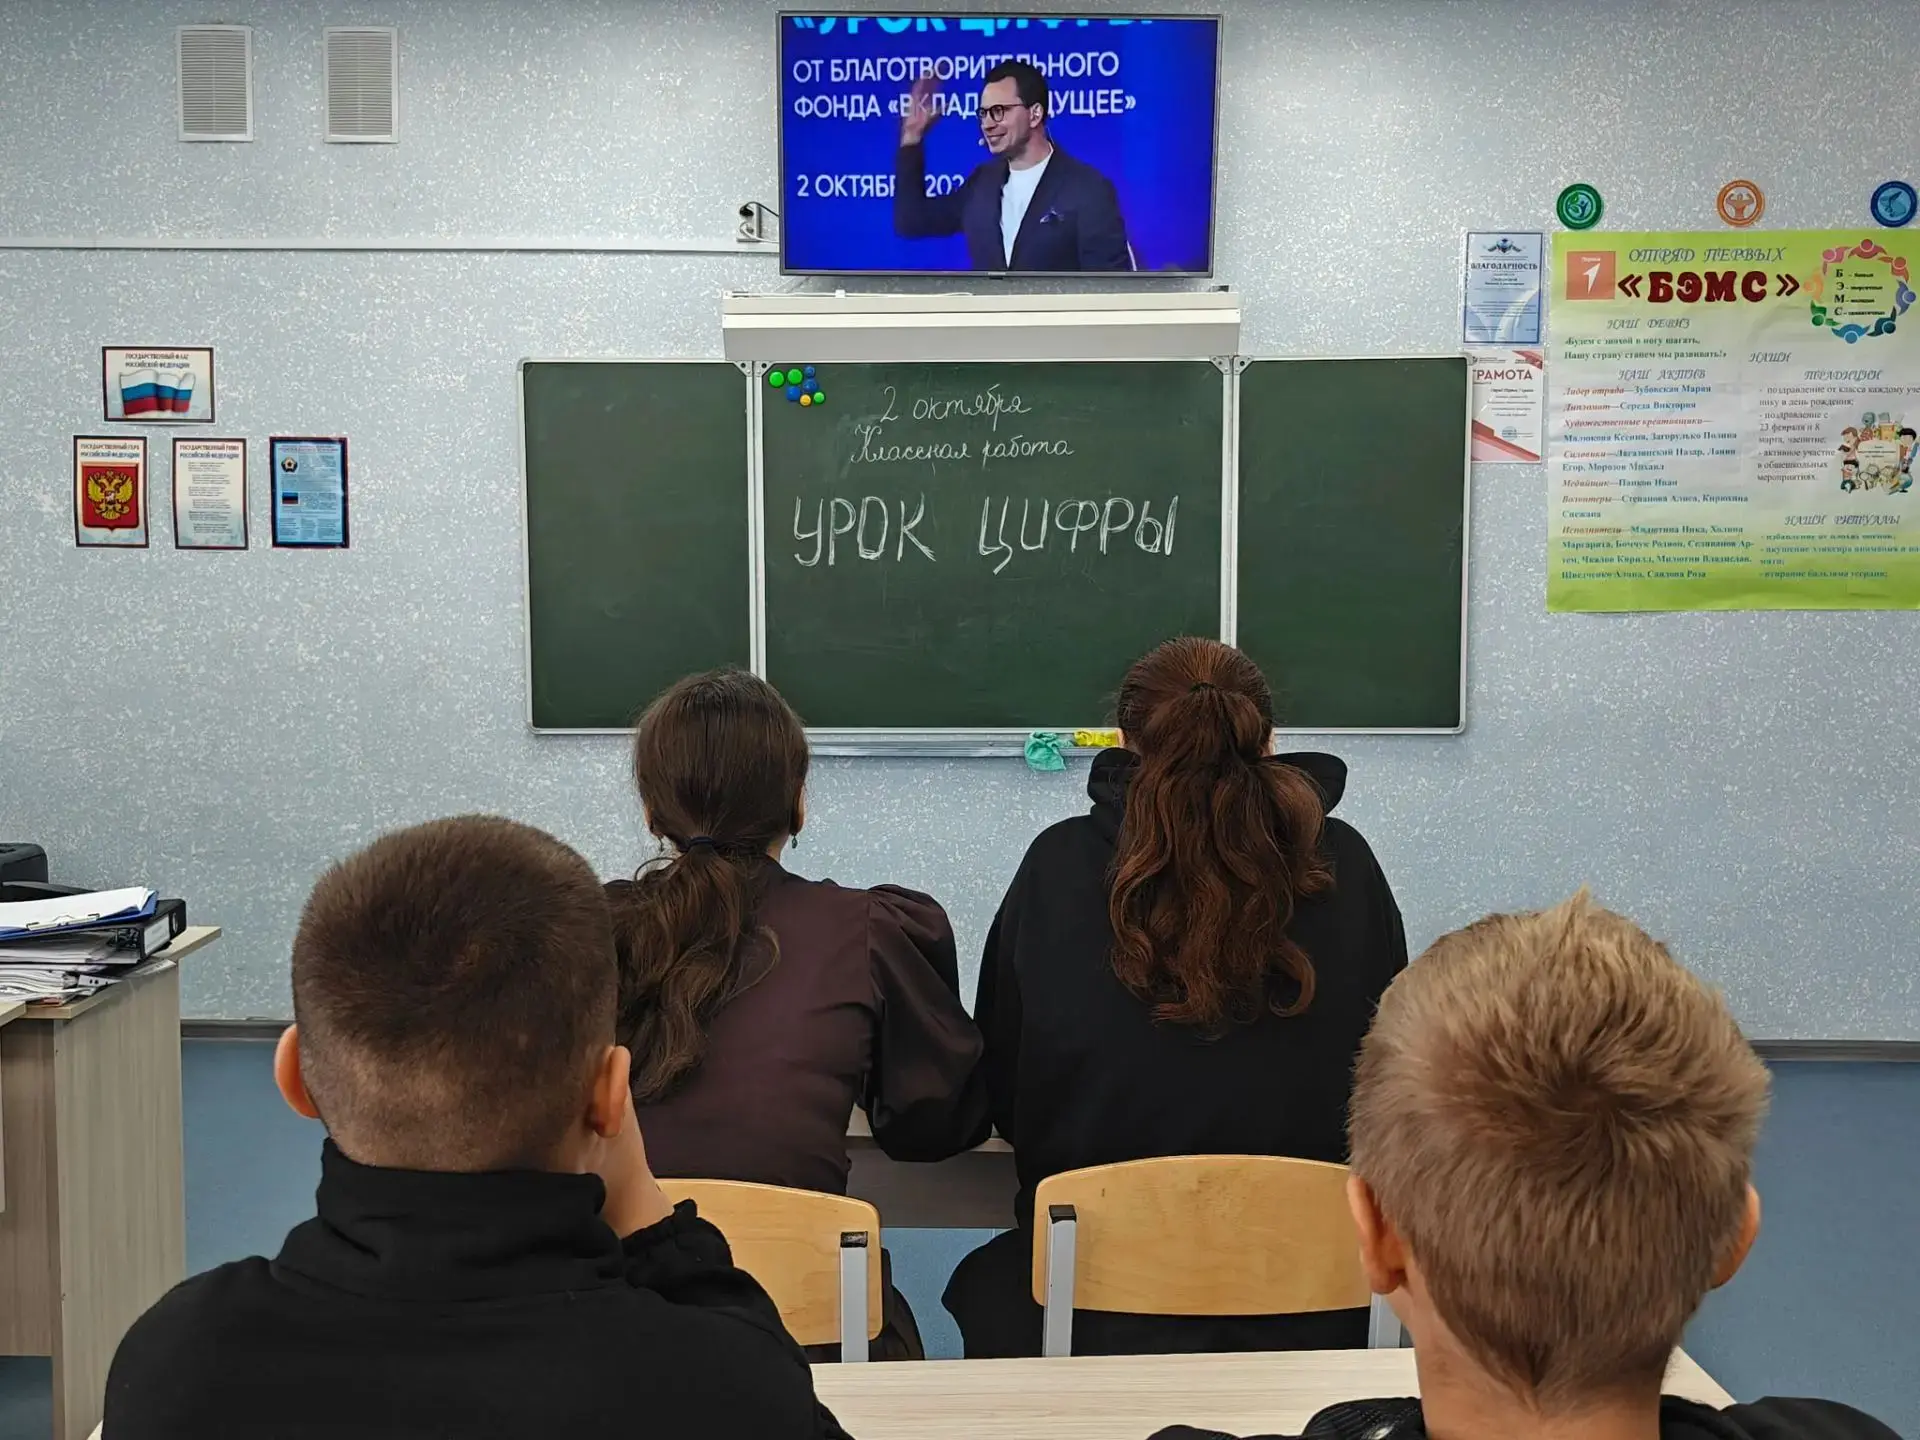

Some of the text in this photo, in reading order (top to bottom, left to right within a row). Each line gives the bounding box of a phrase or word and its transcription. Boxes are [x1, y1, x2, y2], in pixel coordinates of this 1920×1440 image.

[793, 60, 824, 83] ОТ
[794, 95, 882, 121] ФОНДА
[797, 174, 809, 198] 2
[1628, 246, 1787, 264] ОТРЯД ПЕРВЫХ
[1606, 318, 1690, 330] НАШ ДЕВИЗ
[1643, 338, 1663, 347] ногу
[1564, 351, 1589, 361] Нашу
[1749, 351, 1792, 363] НАШИ
[1618, 368, 1706, 380] НАШ АКТИВ
[1804, 369, 1883, 381] ТРАДИЦИИ
[1681, 385, 1711, 395] Мария
[880, 383, 1032, 432] 2 октября
[1759, 423, 1769, 432] 23
[850, 424, 1075, 468] Классная работа
[1562, 463, 1586, 472] Егор,
[1784, 513, 1901, 526] НАШИ РИТУАЛЫ
[793, 494, 1179, 576] УРОК ЦИФРЫ
